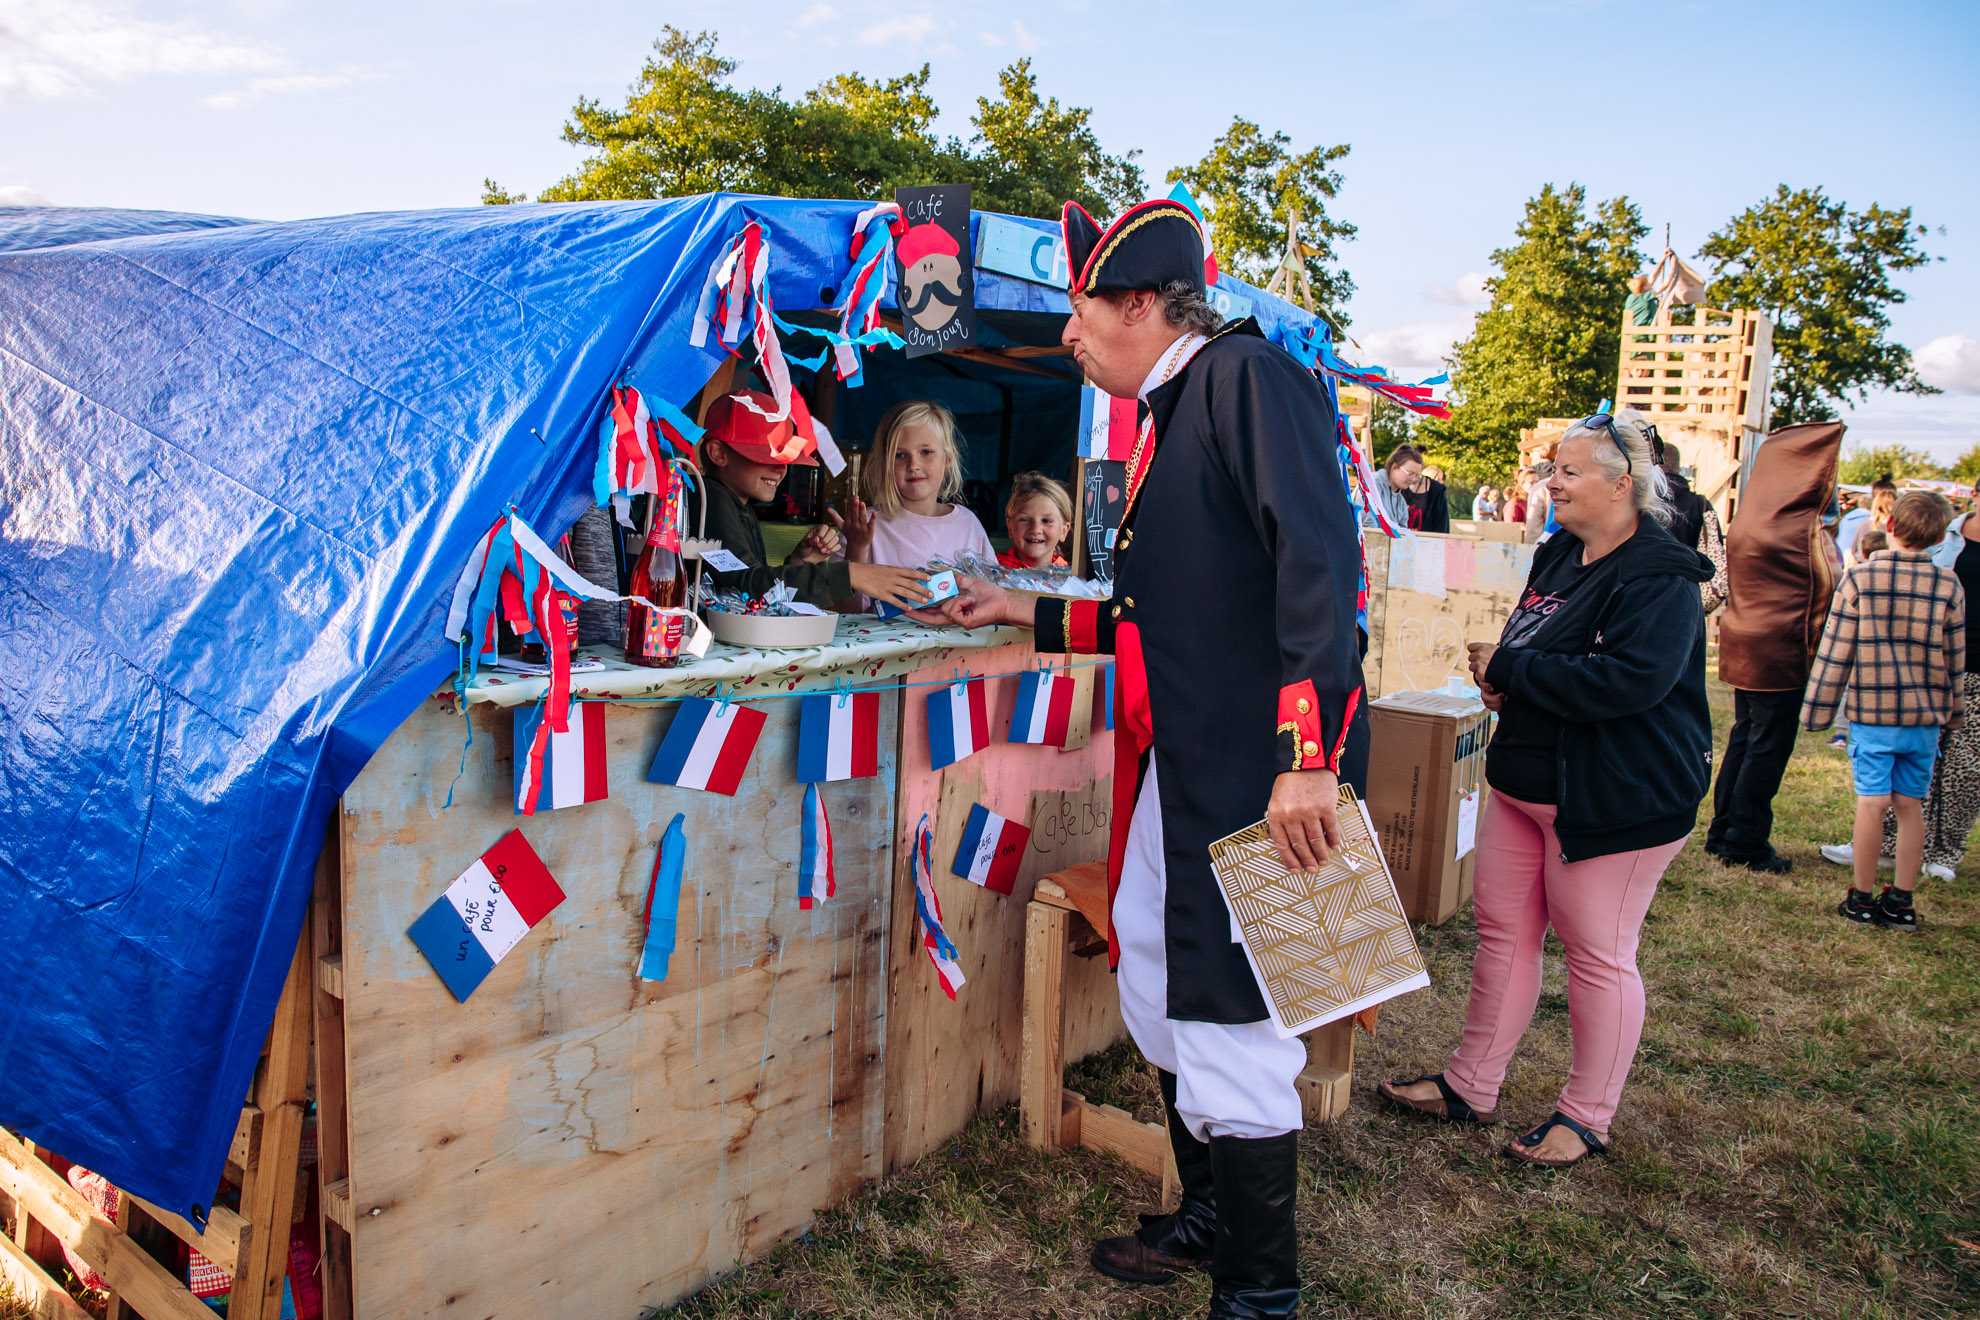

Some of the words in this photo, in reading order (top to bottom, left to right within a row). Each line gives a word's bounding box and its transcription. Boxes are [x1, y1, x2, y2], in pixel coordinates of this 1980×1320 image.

[1031, 235, 1071, 283] CA
[1366, 544, 1388, 572] NCE
[1411, 766, 1420, 808] NETHERLANDS
[1032, 801, 1078, 853] Cafe
[1082, 803, 1113, 836] Bo
[1409, 821, 1415, 829] TO
